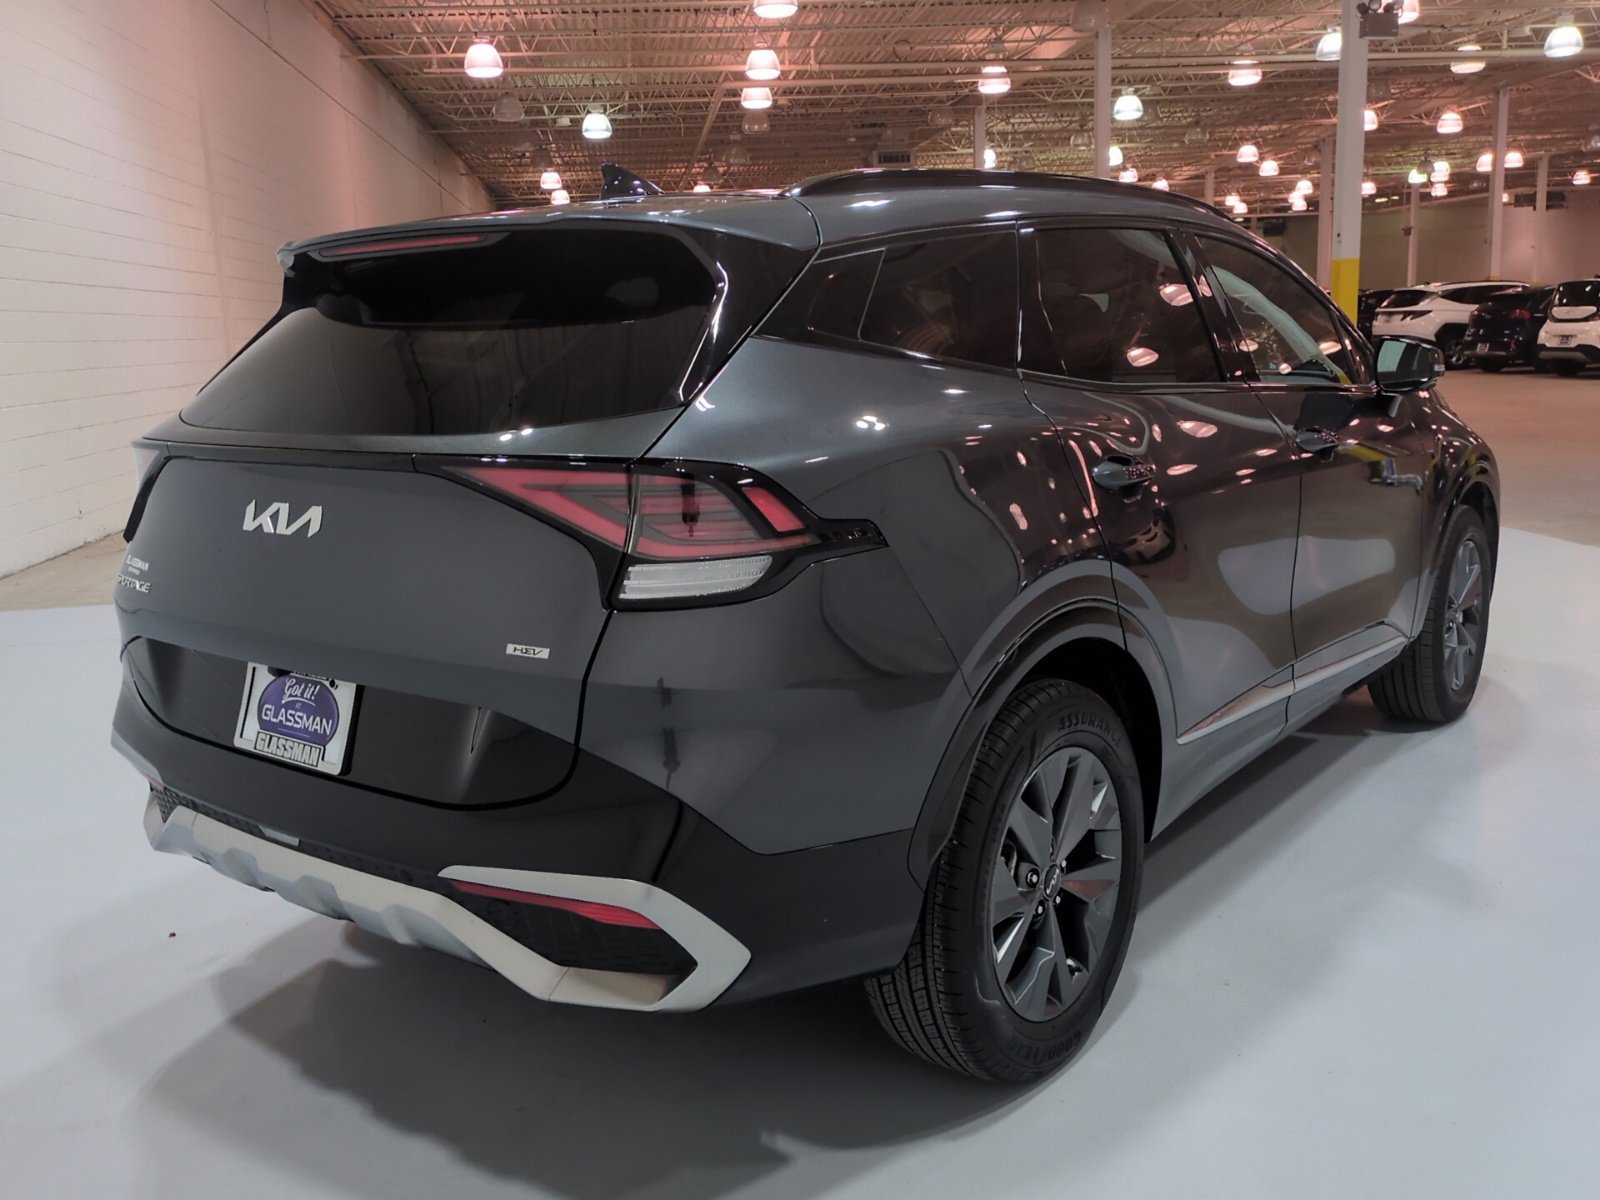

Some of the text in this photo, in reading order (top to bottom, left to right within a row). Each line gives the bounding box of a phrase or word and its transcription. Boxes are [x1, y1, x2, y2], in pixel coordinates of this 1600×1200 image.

[242, 499, 322, 538] KIA
[283, 678, 321, 701] Got it!
[261, 704, 332, 736] GLASSMAN
[256, 733, 320, 766] GLASSMAN
